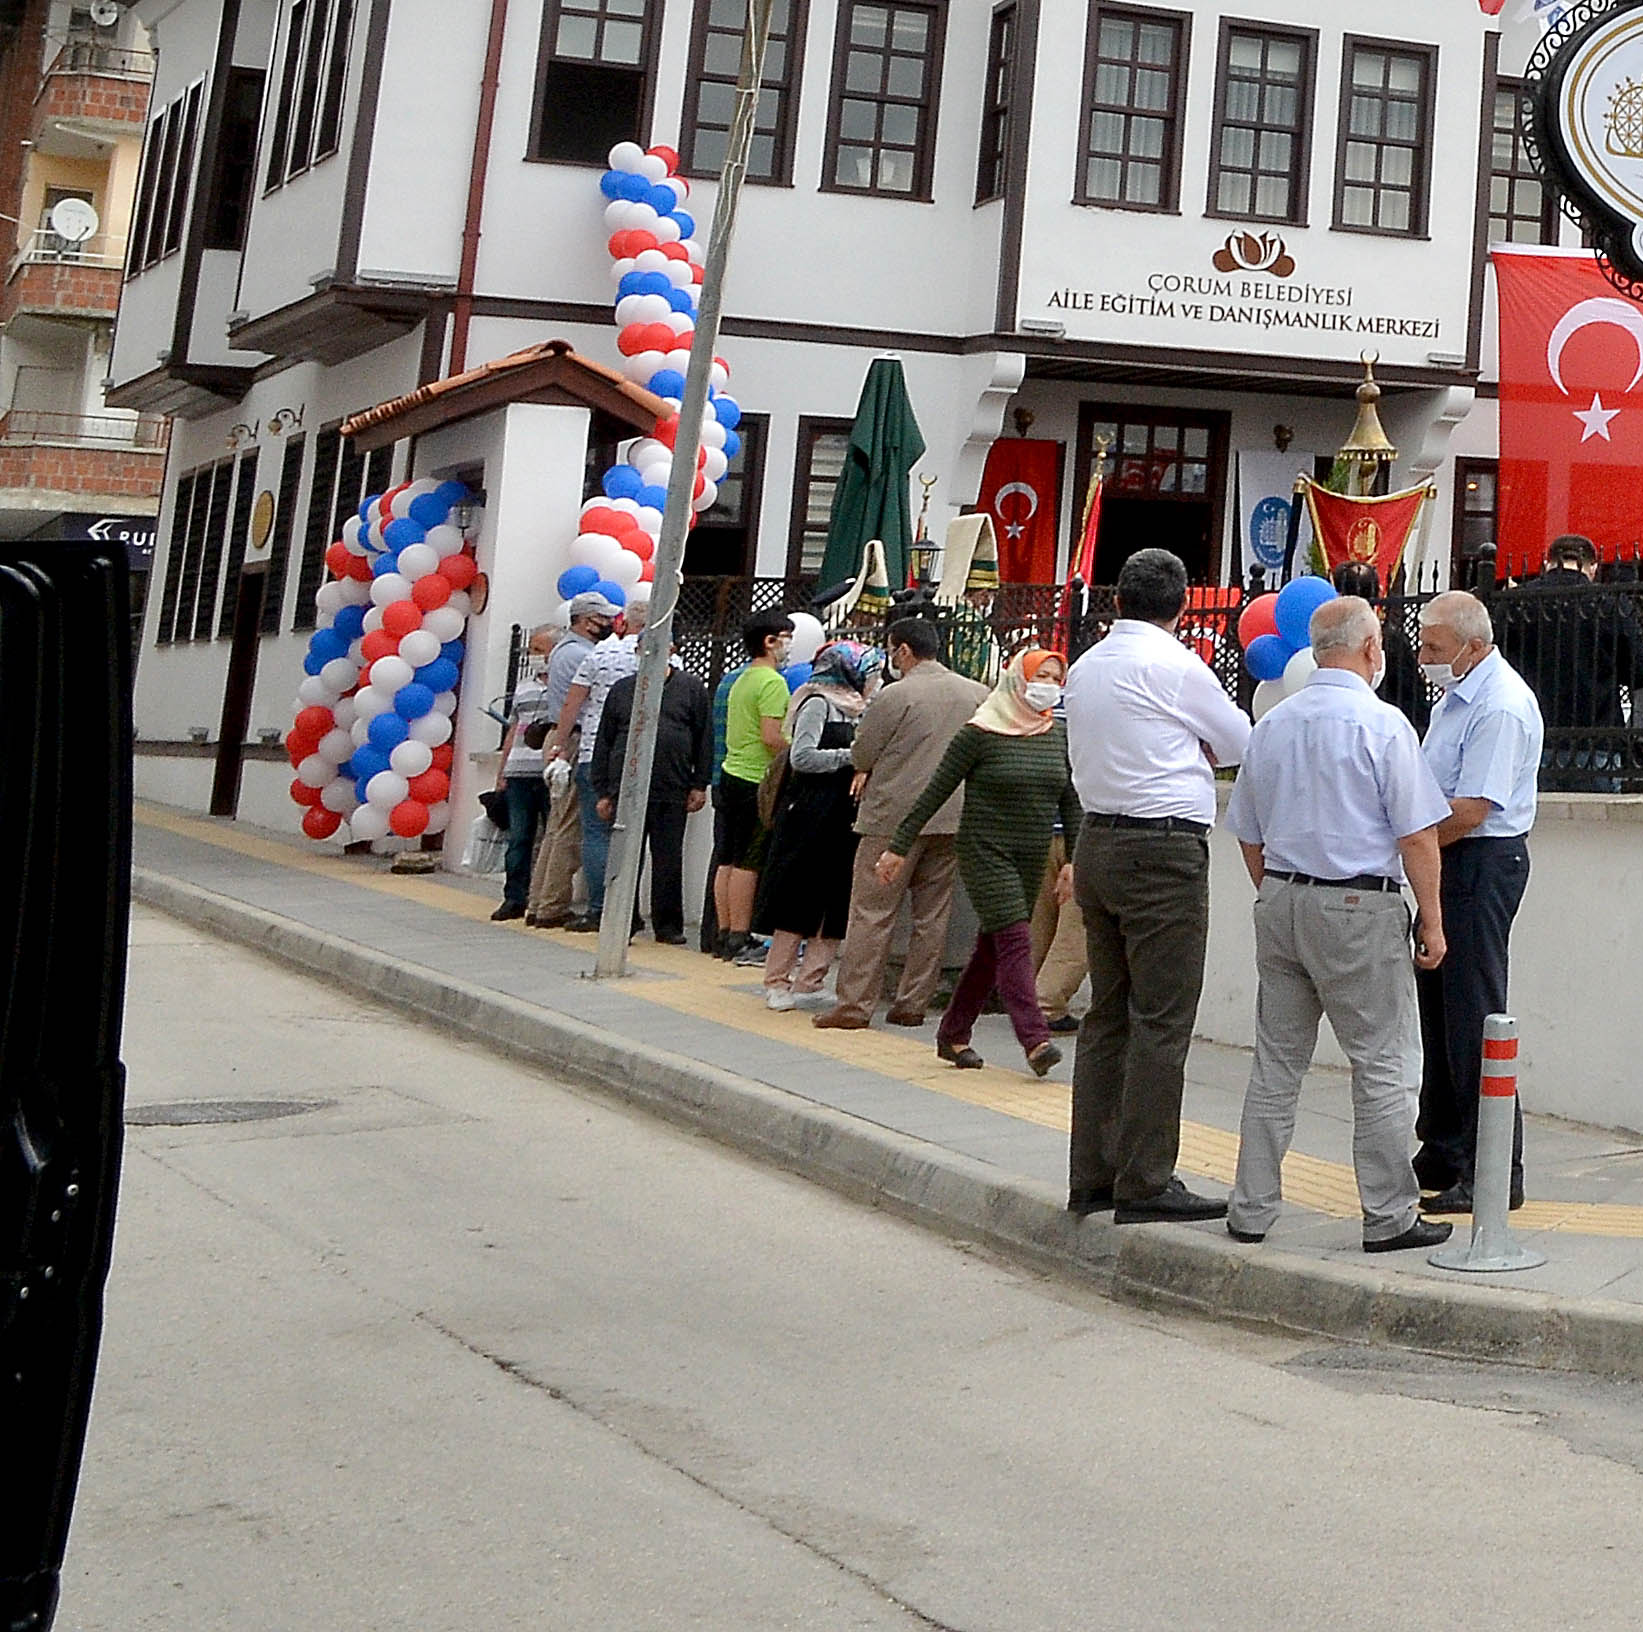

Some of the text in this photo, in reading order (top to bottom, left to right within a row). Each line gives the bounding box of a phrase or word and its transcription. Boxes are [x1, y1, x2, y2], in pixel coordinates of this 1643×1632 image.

[1148, 274, 1353, 306] ÇORUM BELEDİYESİ
[1047, 288, 1440, 339] AİLE EĞİTİM VE DANIŞMANLIK MERKEZİ
